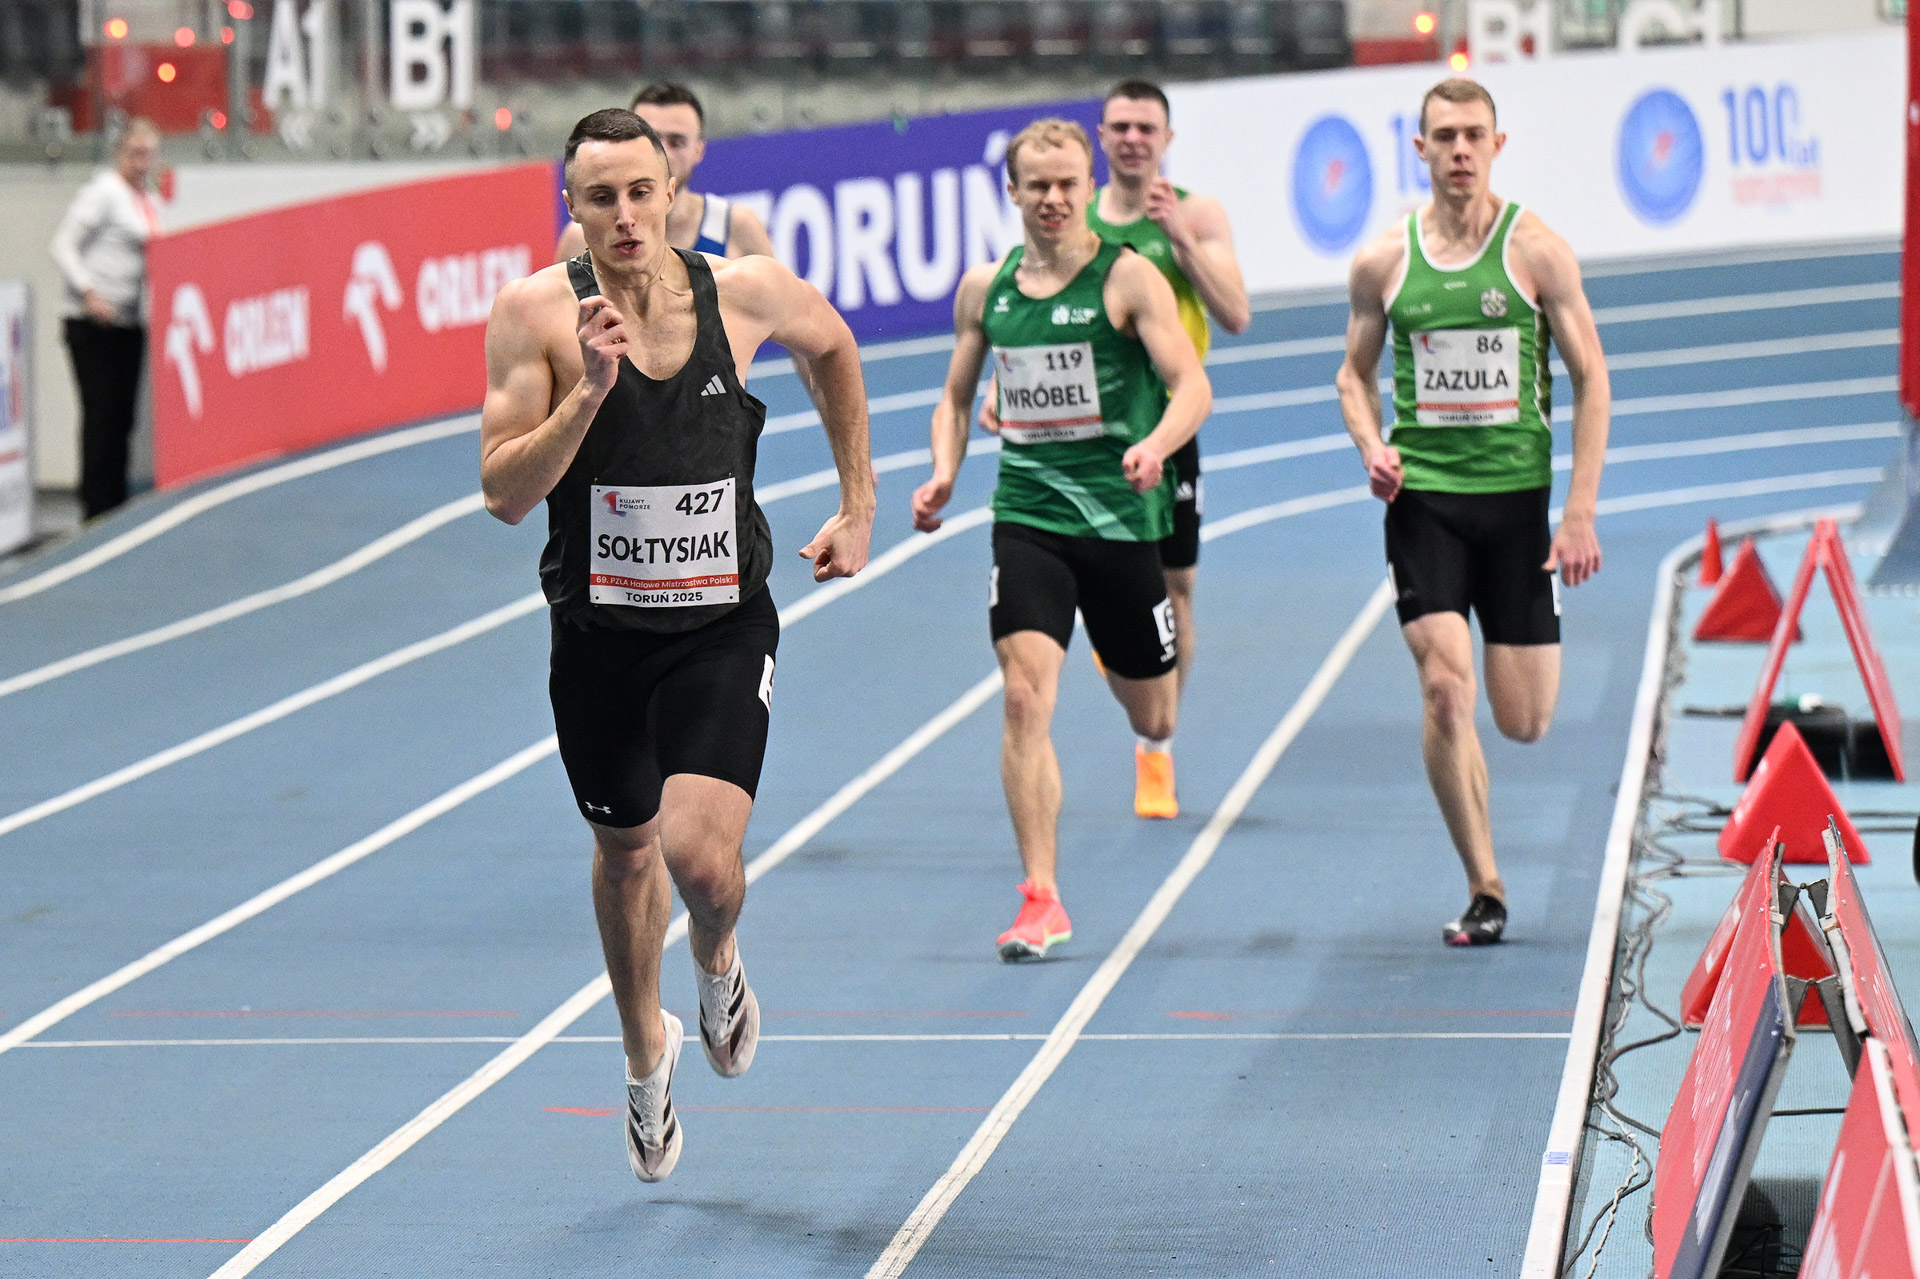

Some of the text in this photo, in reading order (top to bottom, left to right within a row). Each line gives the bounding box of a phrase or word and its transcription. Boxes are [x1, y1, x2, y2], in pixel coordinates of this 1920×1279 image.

[262, 0, 325, 109] A1
[390, 0, 473, 109] B1
[722, 130, 1025, 311] ORUŃ
[1476, 335, 1503, 354] 86
[1044, 350, 1083, 371] 119
[1423, 368, 1509, 391] ZAZULA
[1003, 382, 1092, 409] WRÓBEL
[675, 488, 725, 516] 427
[597, 530, 731, 564] SOŁTYSIAK
[596, 575, 733, 589] 69. PZLA Halowe Mistrzostwa Polski
[626, 591, 703, 603] TORUŃ 2025
